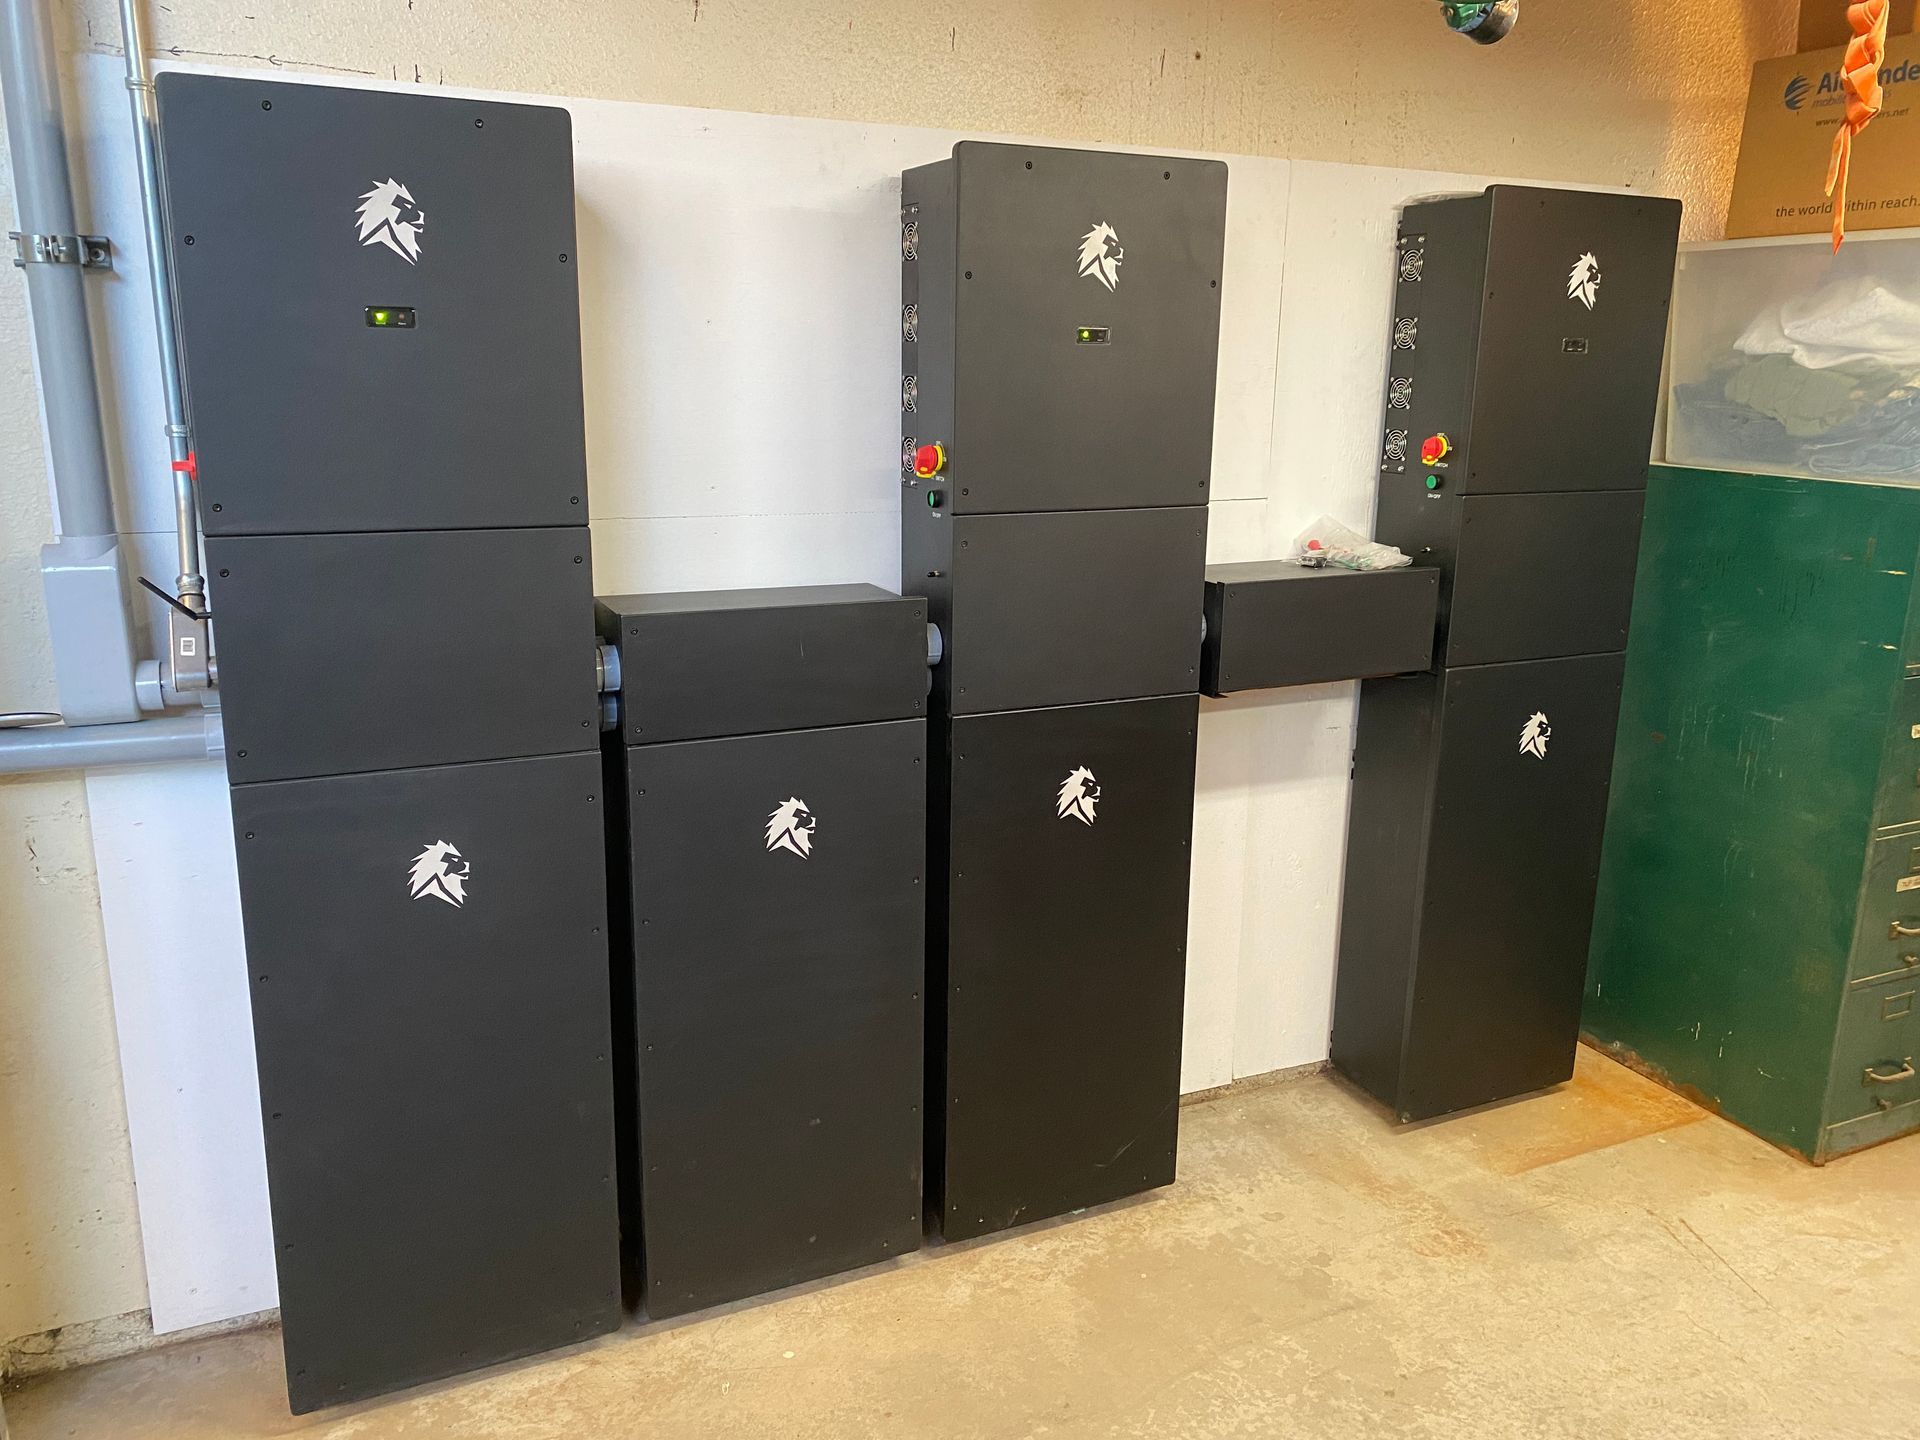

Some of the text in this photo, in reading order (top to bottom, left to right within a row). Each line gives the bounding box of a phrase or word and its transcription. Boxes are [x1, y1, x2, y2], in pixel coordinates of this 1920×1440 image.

[1776, 194, 1920, 218] the world ithin reach.
